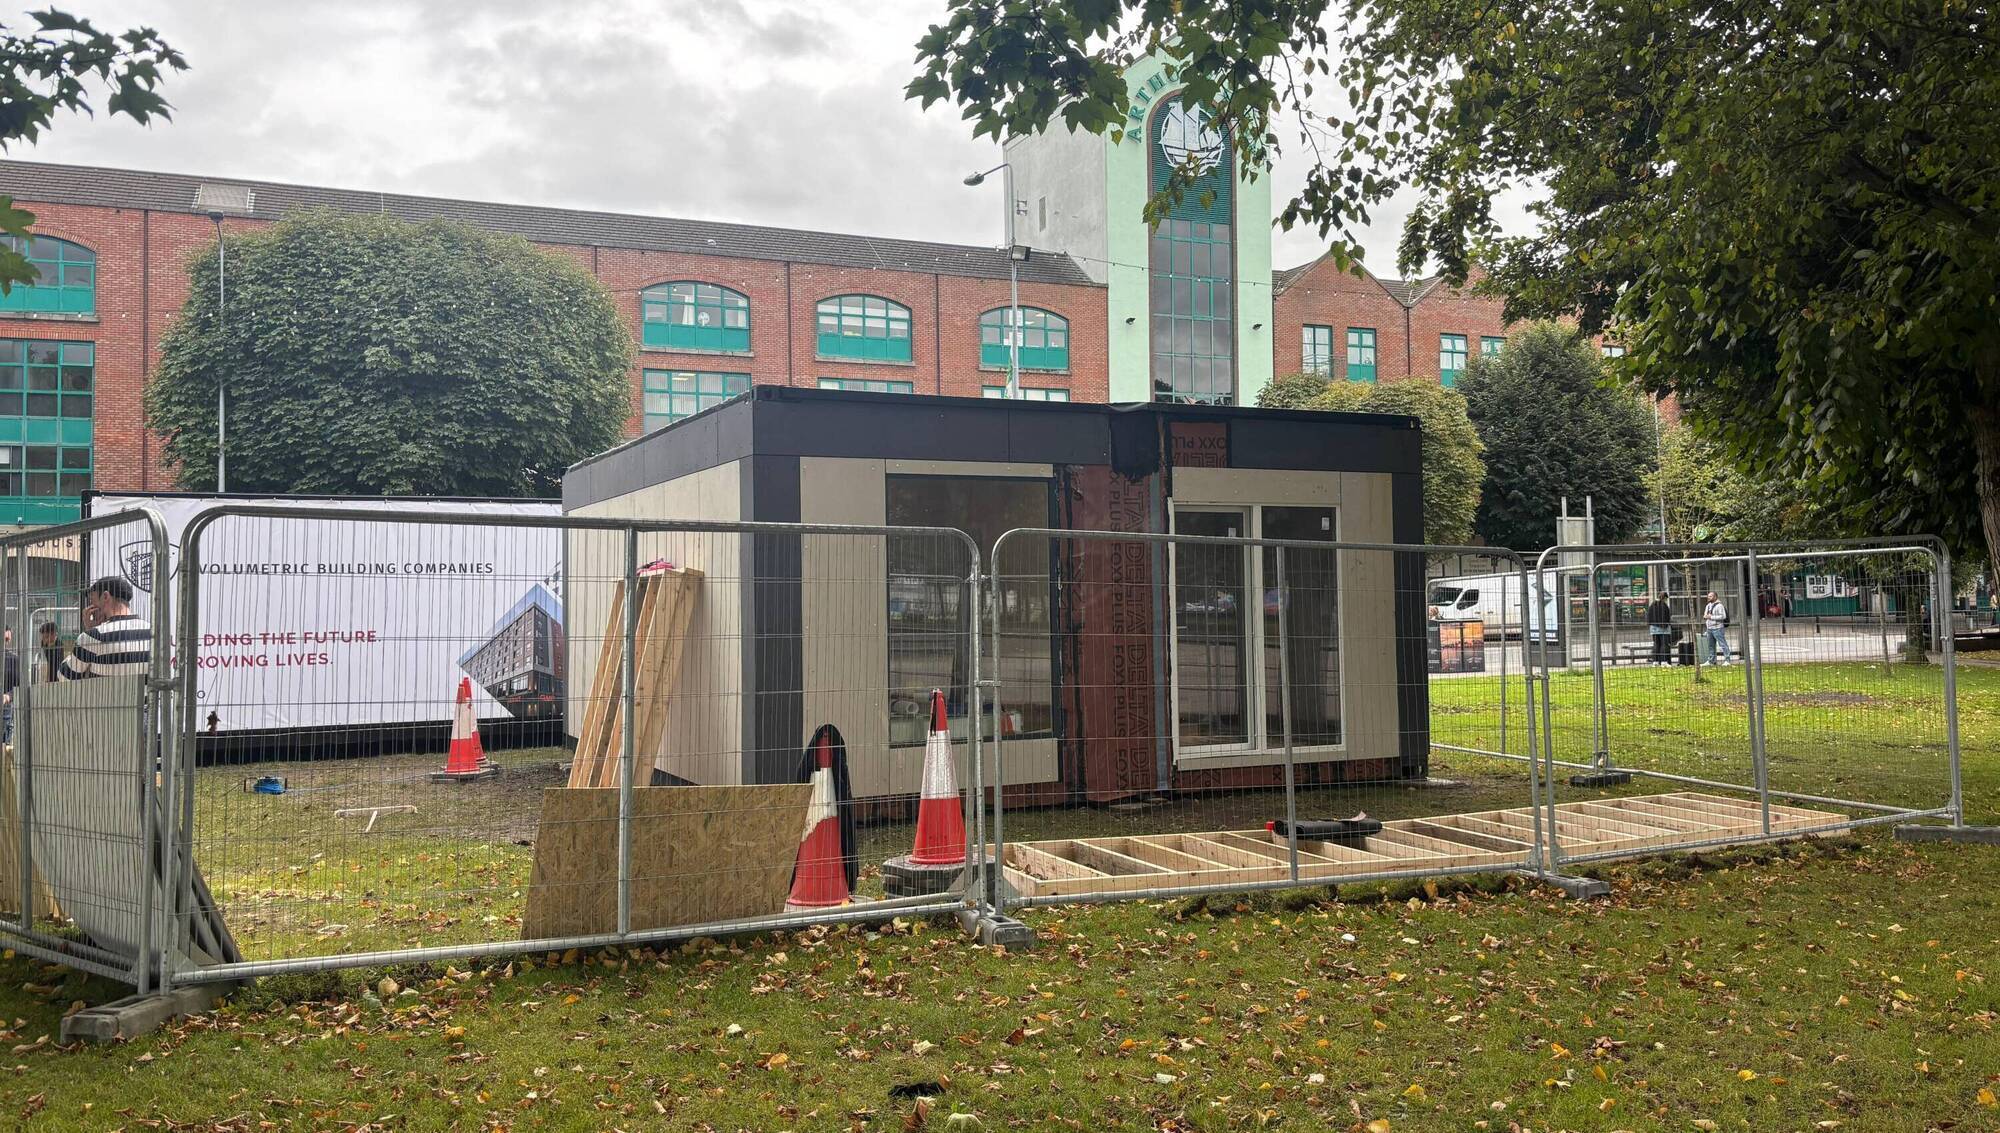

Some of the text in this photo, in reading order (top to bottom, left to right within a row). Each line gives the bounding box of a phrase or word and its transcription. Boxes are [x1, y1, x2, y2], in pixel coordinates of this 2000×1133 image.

[1127, 63, 1181, 144] ARTHU
[1171, 436, 1226, 449] OXX PLU
[1123, 478, 1145, 532] LTA
[199, 562, 494, 575] VOLUMETRIC BUILDING COMPANIES
[1125, 542, 1147, 635] DELTA
[171, 631, 381, 647] UDING THE FUTURE.
[171, 653, 333, 668] ROVING LIVES.
[1127, 644, 1149, 738] DELTA
